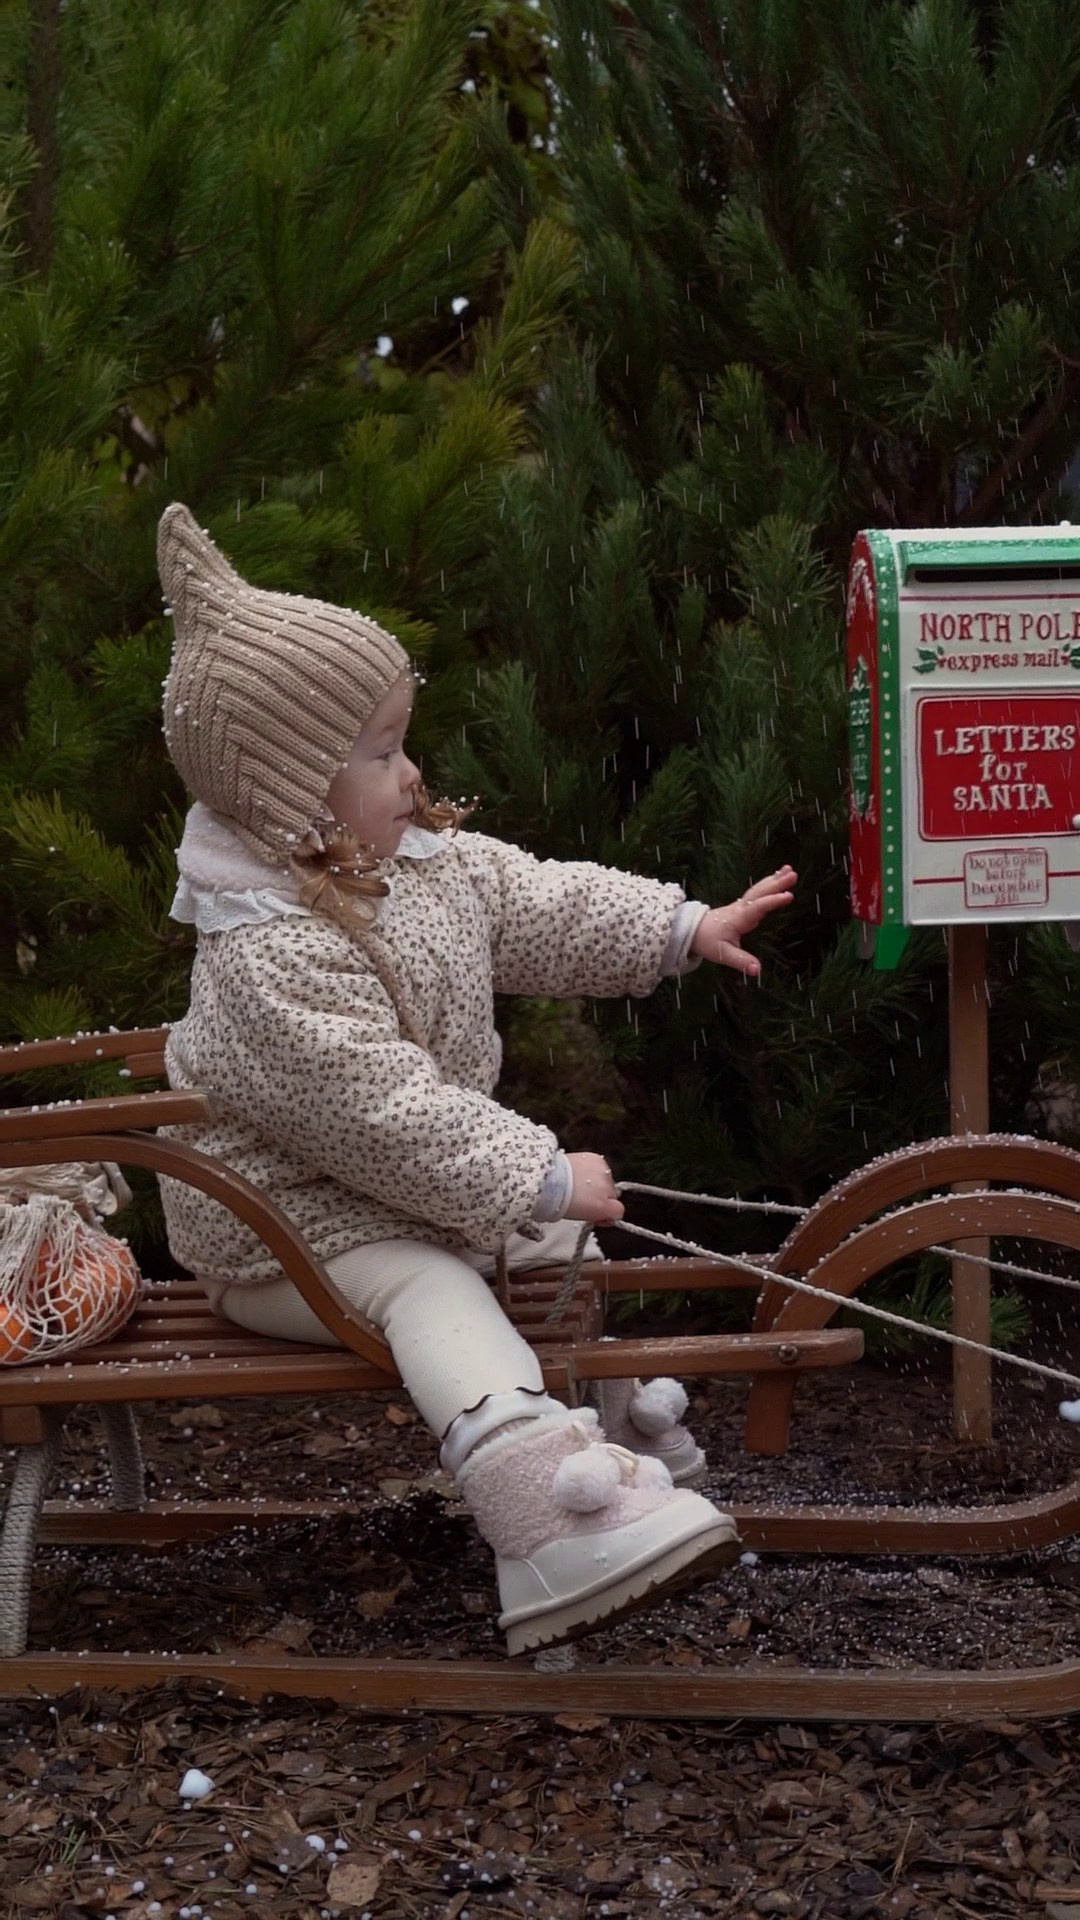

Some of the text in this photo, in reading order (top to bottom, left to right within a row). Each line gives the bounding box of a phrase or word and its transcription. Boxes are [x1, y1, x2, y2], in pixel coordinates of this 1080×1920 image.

[920, 613, 1011, 642] NORTH
[948, 648, 1059, 672] express mail
[934, 725, 1076, 756] LETTERS
[979, 754, 1028, 782] for
[953, 784, 1053, 811] SANTA
